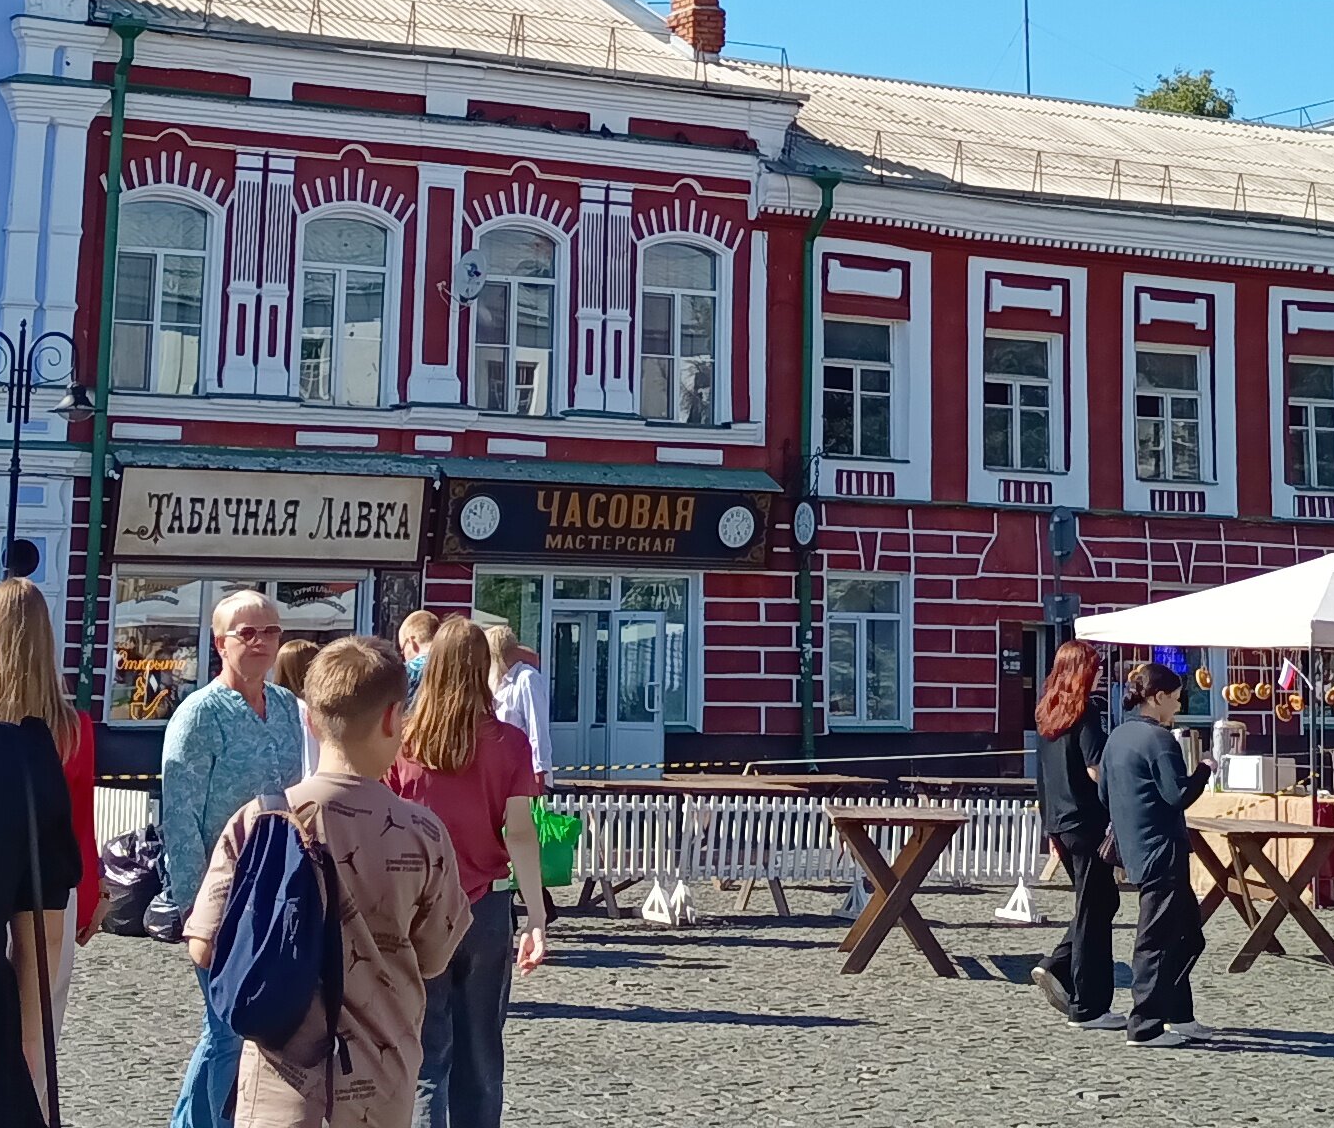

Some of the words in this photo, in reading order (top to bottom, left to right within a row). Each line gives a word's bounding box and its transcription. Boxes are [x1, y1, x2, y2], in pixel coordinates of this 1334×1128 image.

[123, 492, 300, 545] ТАБАЧНАЯ
[308, 497, 412, 540] ЛАВКА
[536, 490, 696, 532] ЧАСОВАЯ
[544, 534, 677, 554] МАСТЕРСКАЯ
[115, 649, 188, 671] Открыто
